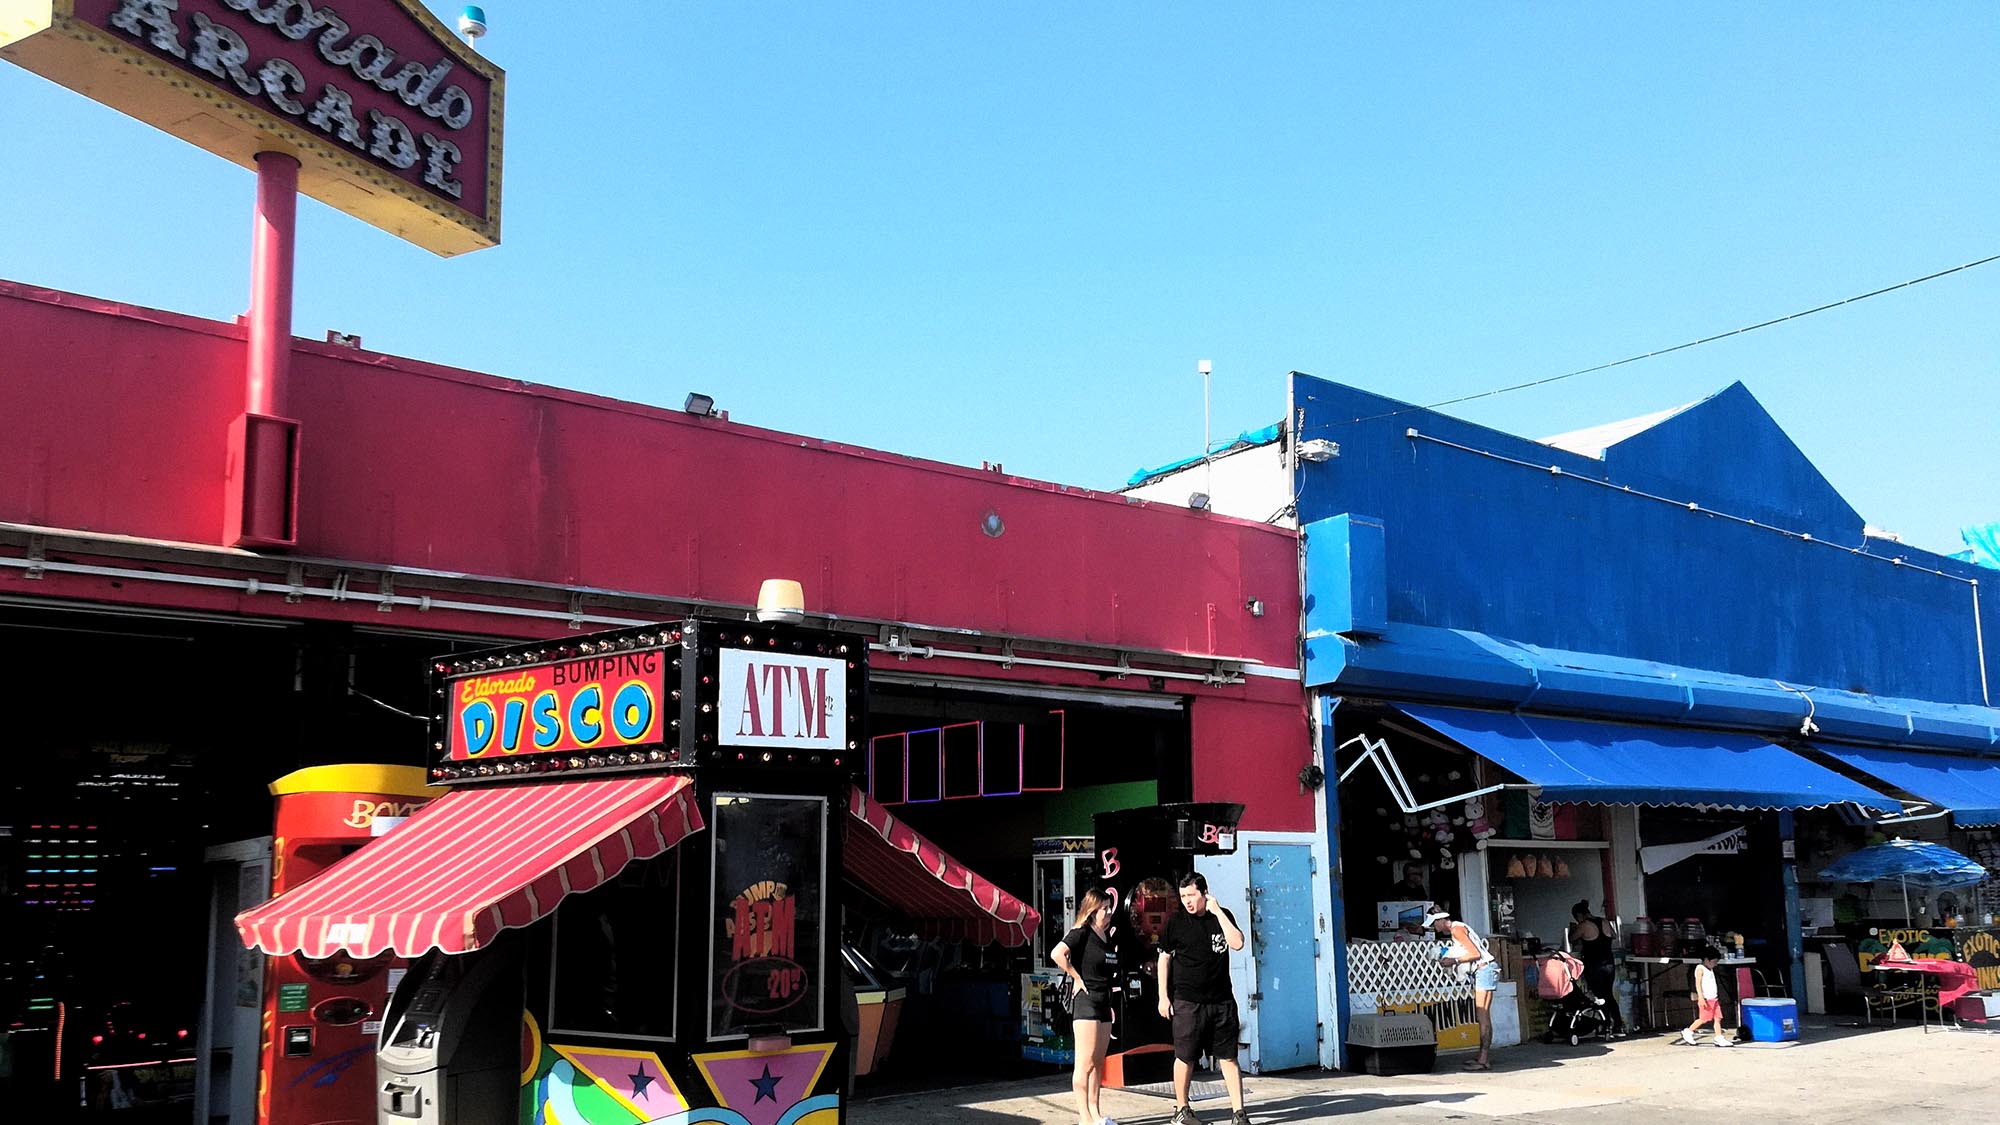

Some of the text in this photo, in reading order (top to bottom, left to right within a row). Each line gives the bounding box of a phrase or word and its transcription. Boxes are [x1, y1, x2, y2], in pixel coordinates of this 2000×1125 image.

[110, 0, 463, 199] ARCADE
[460, 671, 536, 703] Eldorado
[553, 650, 657, 686] BUMPING
[736, 662, 831, 740] ATM
[460, 679, 656, 758] DISCO
